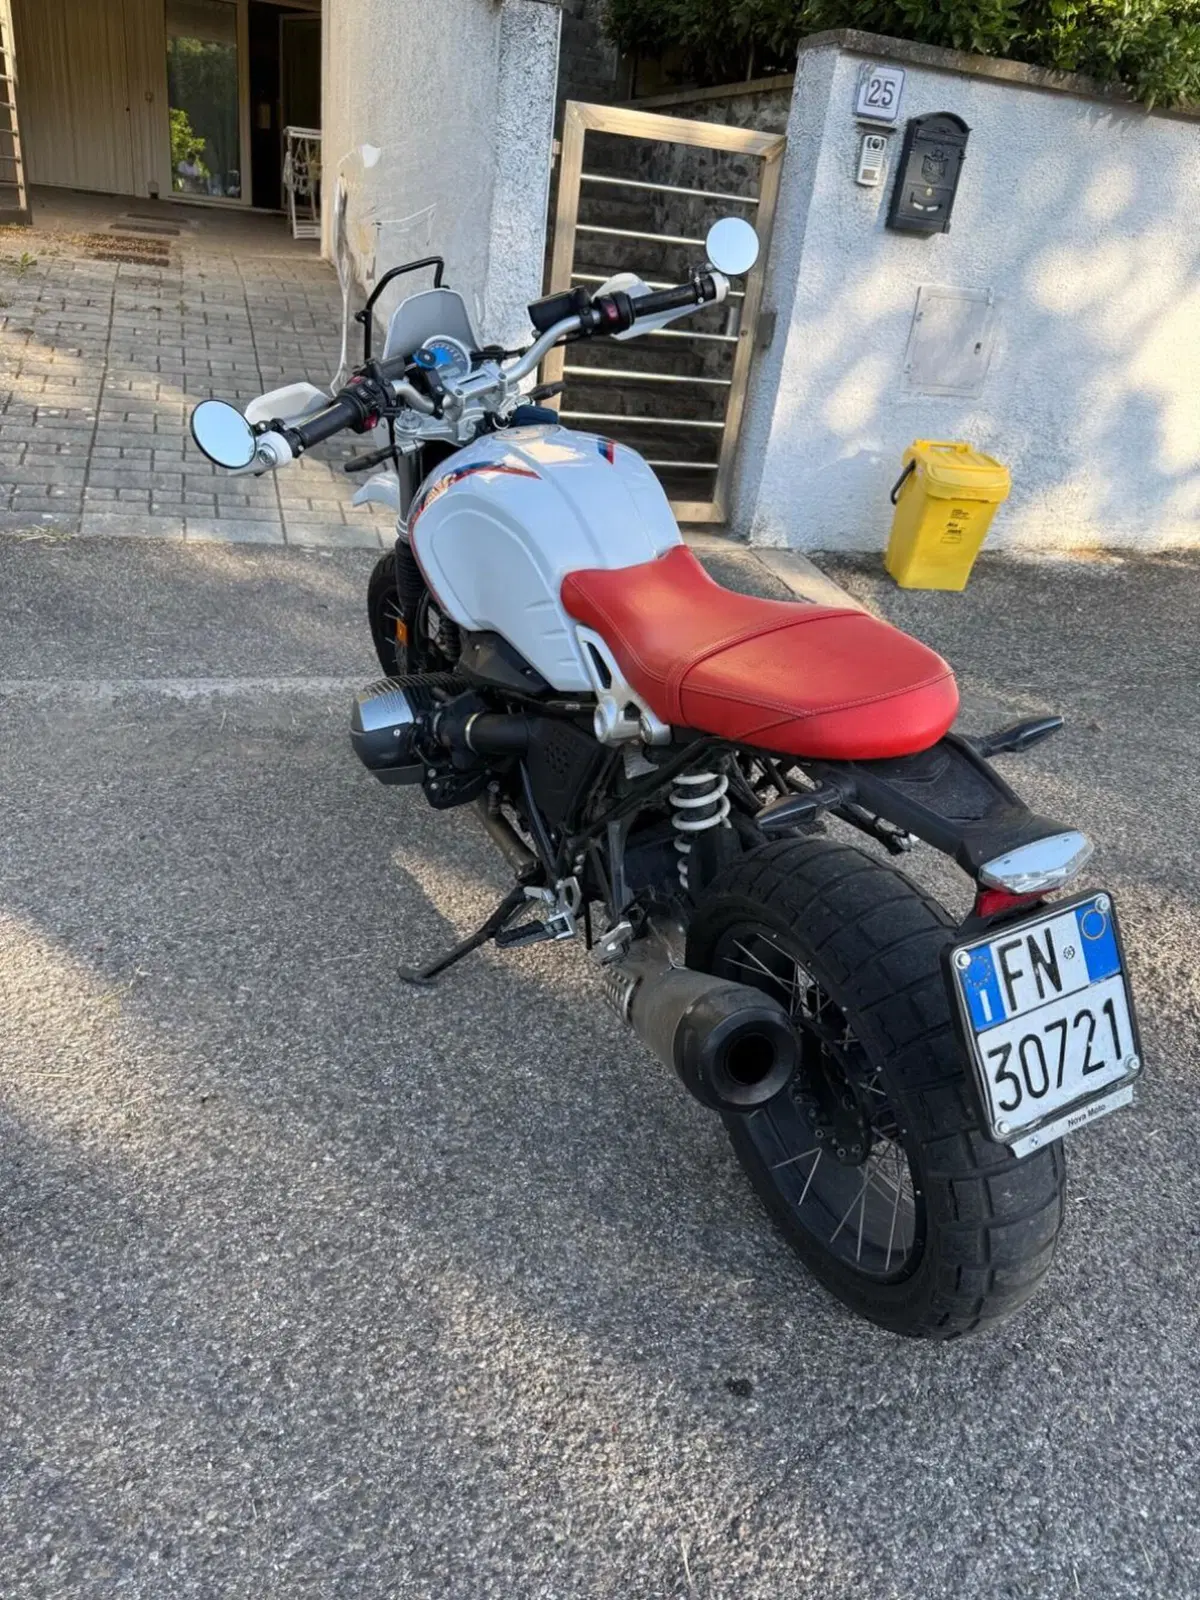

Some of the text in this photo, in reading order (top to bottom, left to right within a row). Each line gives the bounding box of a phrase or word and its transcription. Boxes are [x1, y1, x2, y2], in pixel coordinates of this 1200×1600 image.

[868, 79, 896, 106] 25
[996, 927, 1063, 1012] FN
[987, 997, 1122, 1112] 30721
[1067, 1104, 1107, 1127] Nova Moto
